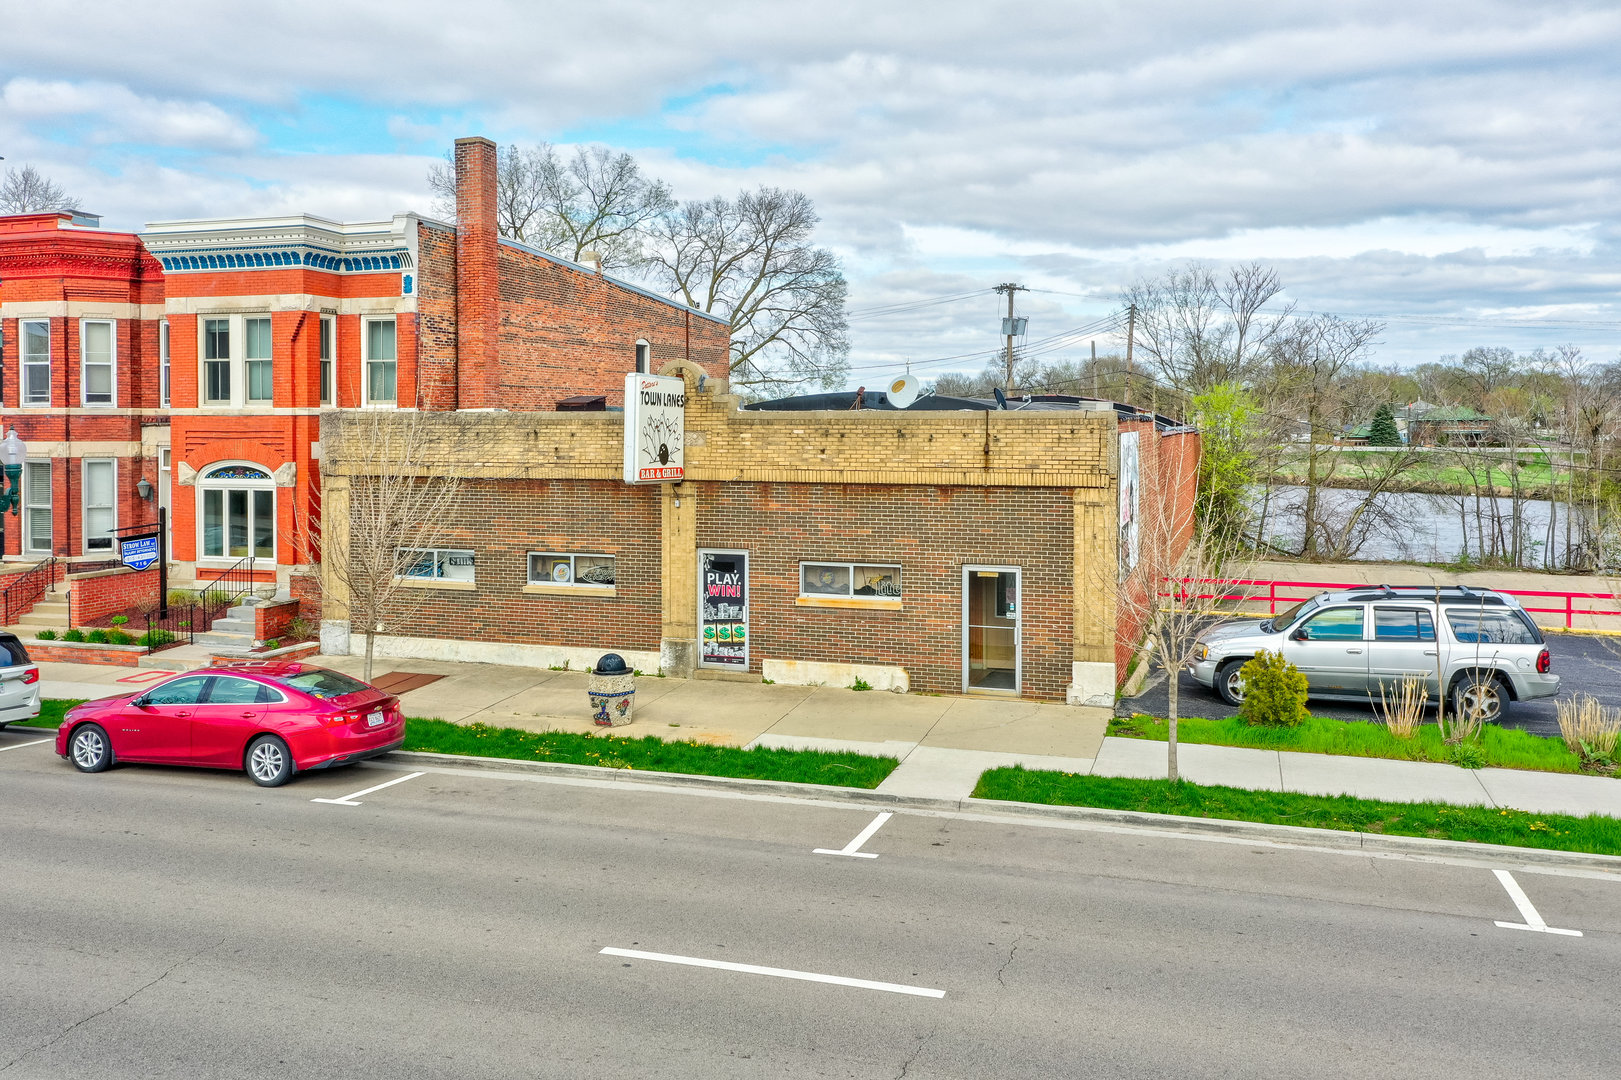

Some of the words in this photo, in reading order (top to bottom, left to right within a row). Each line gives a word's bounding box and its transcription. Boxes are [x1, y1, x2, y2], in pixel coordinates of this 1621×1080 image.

[641, 391, 662, 407] TOWN
[663, 393, 685, 408] LANES
[641, 469, 655, 478] BAR
[656, 469, 662, 478] &
[662, 468, 682, 477] GRILL
[707, 584, 741, 598] WIN!
